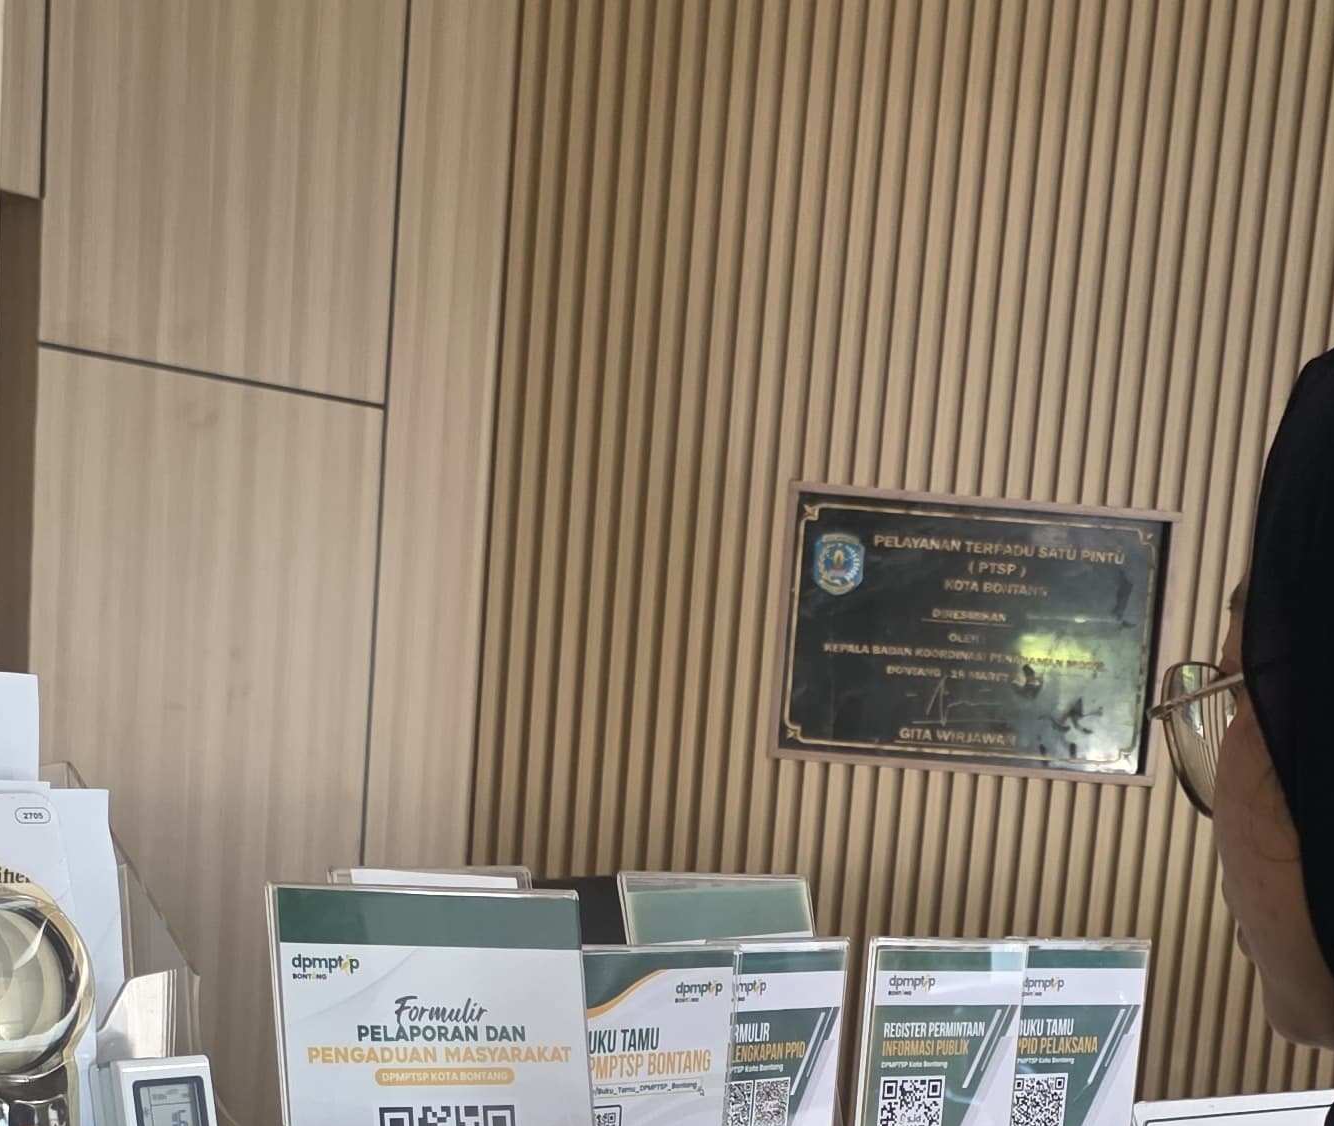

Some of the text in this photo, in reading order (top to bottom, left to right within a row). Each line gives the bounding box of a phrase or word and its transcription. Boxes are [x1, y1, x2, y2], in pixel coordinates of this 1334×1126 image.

[874, 534, 1124, 564] PELAYANAN TERPADU SATU PINTU
[979, 563, 1017, 575] PTSP
[899, 727, 932, 742] GITA
[395, 996, 489, 1025] Formulir
[357, 1025, 526, 1042] PELAPORAN DAN
[734, 1022, 770, 1043] RMULIR
[883, 1021, 986, 1038] REGISTER PERMINTAAN
[1046, 1018, 1074, 1036] TAMU
[588, 1027, 660, 1054] UKU TAMU
[882, 1040, 970, 1057] INFORMASI PUBLIK
[1040, 1035, 1098, 1055] PELAKSANA
[307, 1046, 572, 1064] PENGADUAN MASYARAKAT
[785, 1041, 806, 1060] PPID
[589, 1049, 711, 1080] PMPTSP BONTANG
[382, 1071, 508, 1082] DPMPTSP KOTA BONTANG
